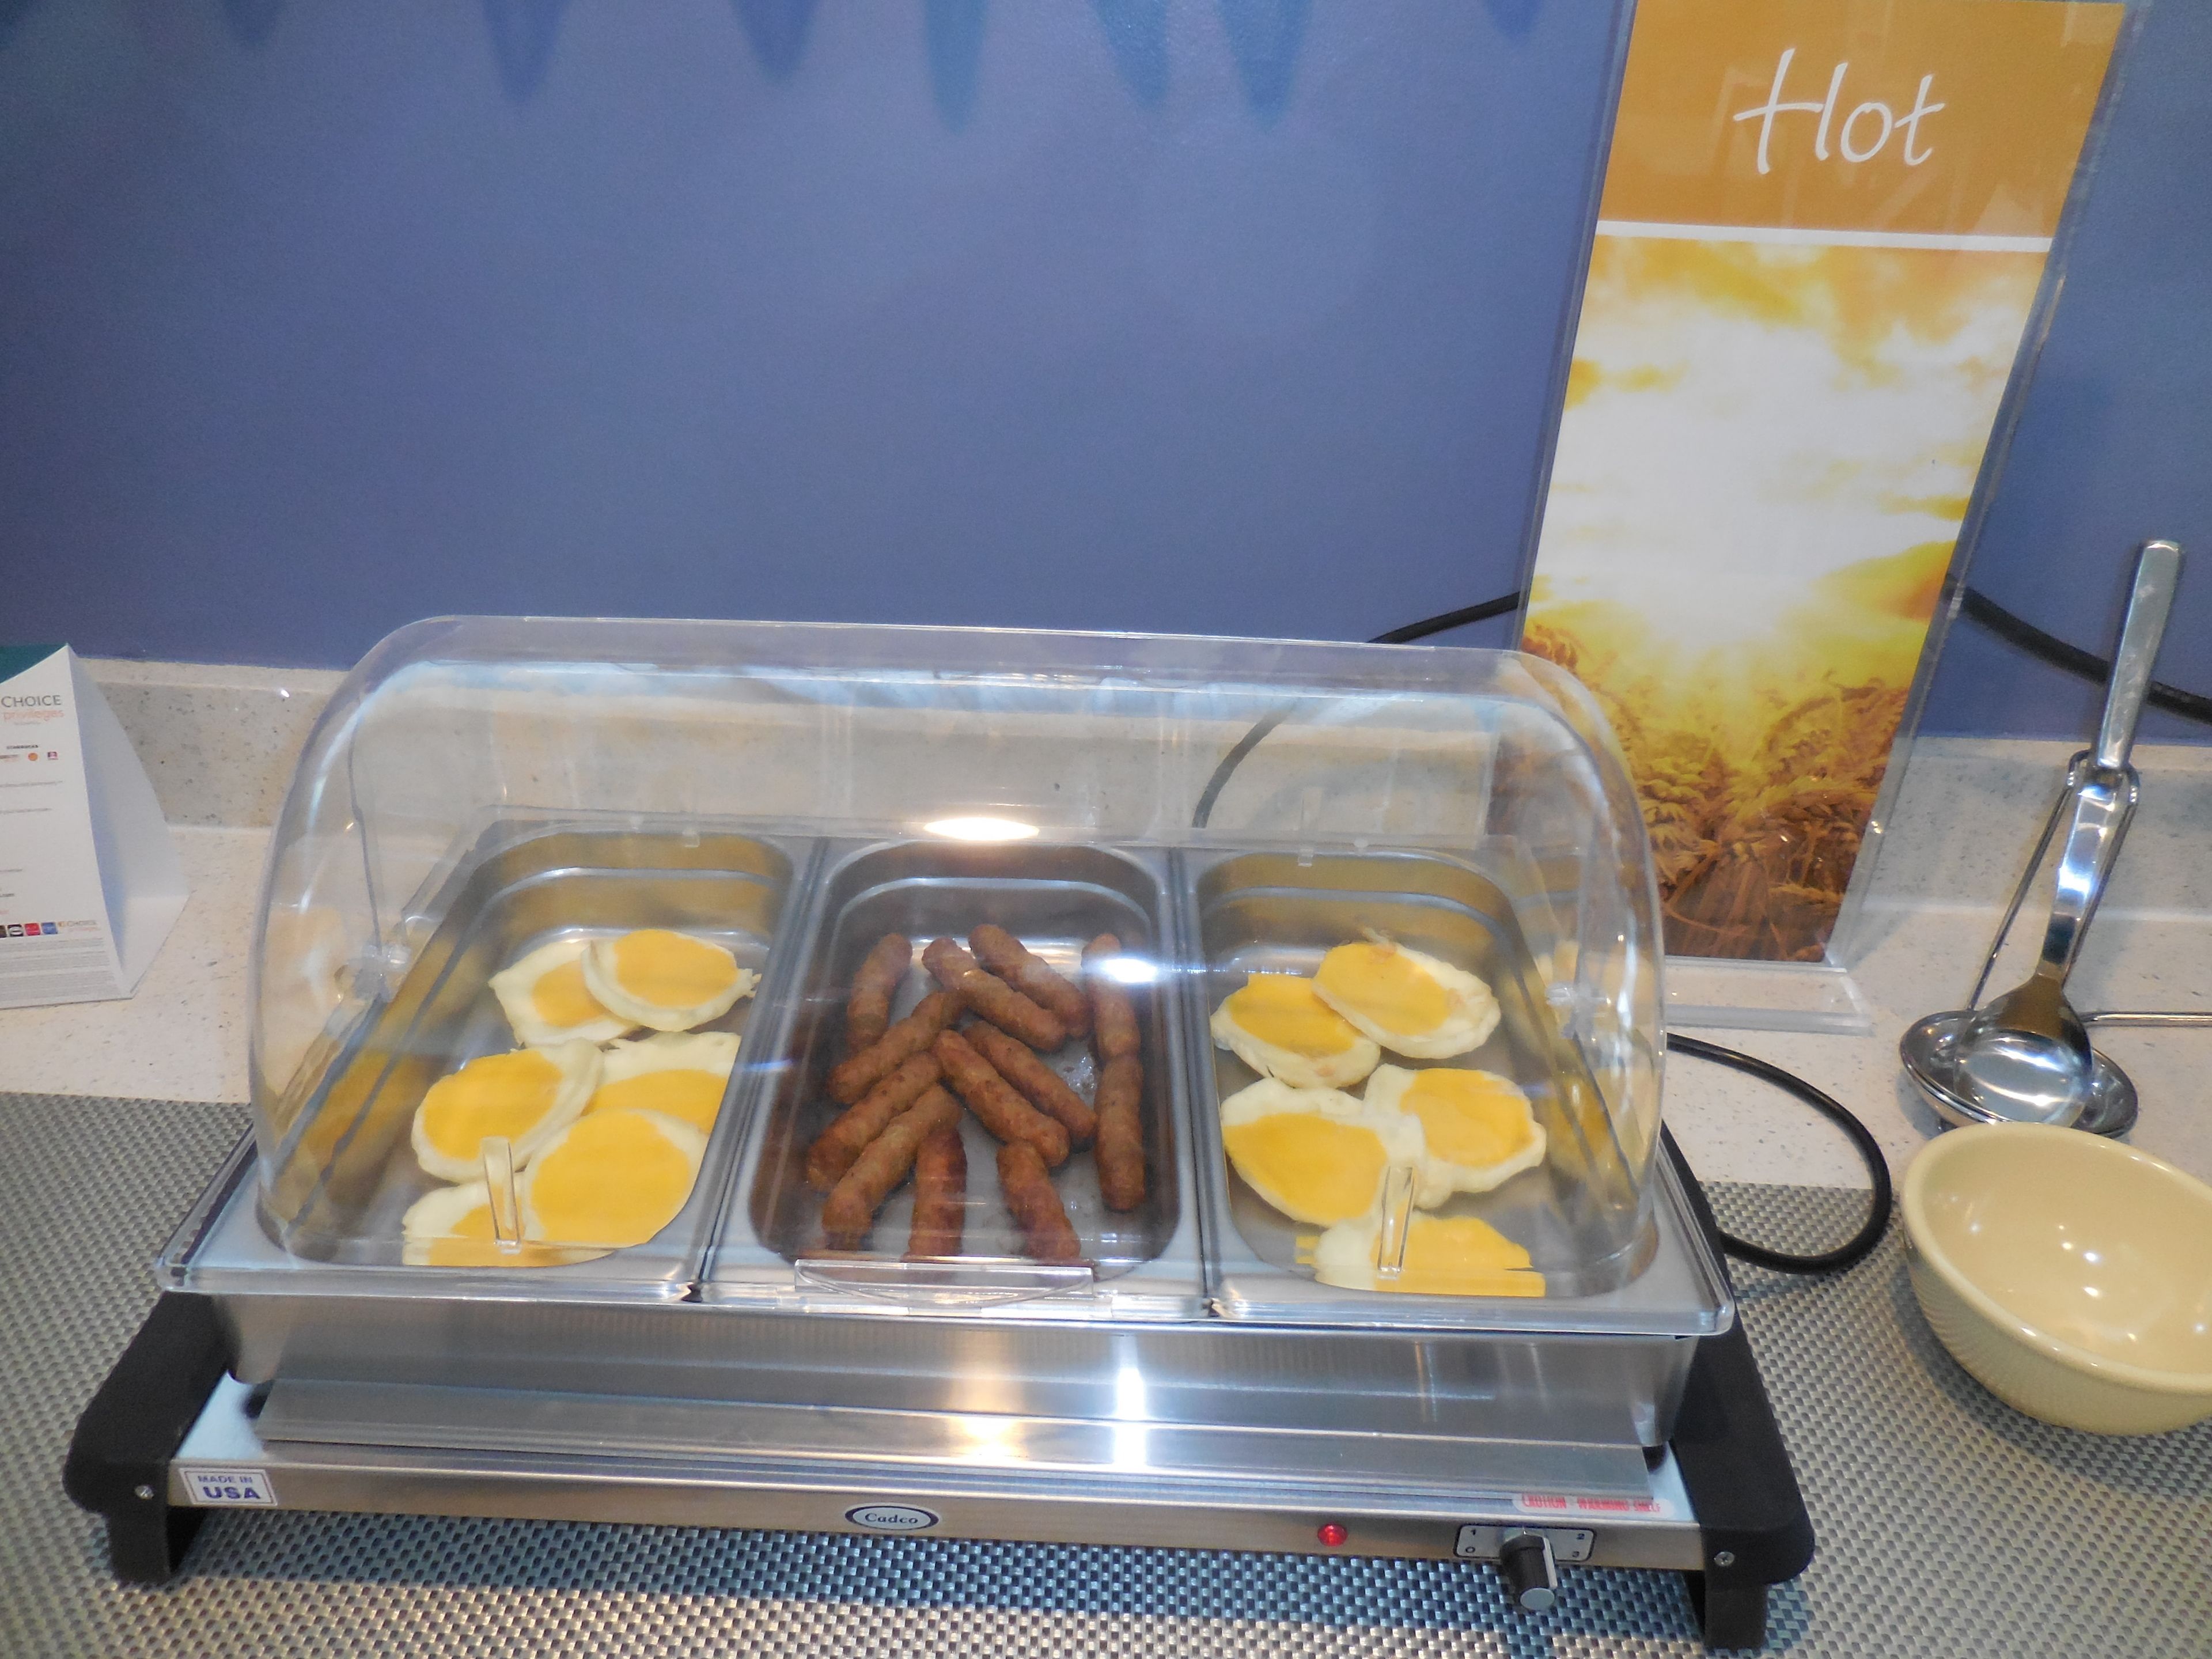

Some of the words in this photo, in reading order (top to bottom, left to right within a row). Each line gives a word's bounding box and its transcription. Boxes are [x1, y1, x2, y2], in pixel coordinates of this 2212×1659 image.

[1733, 48, 1947, 175] Hot
[1, 695, 62, 708] CHOICE
[198, 1475, 236, 1483] MADE
[240, 1476, 253, 1484] IN
[203, 1486, 261, 1499] USA
[865, 1512, 918, 1524] Cadco
